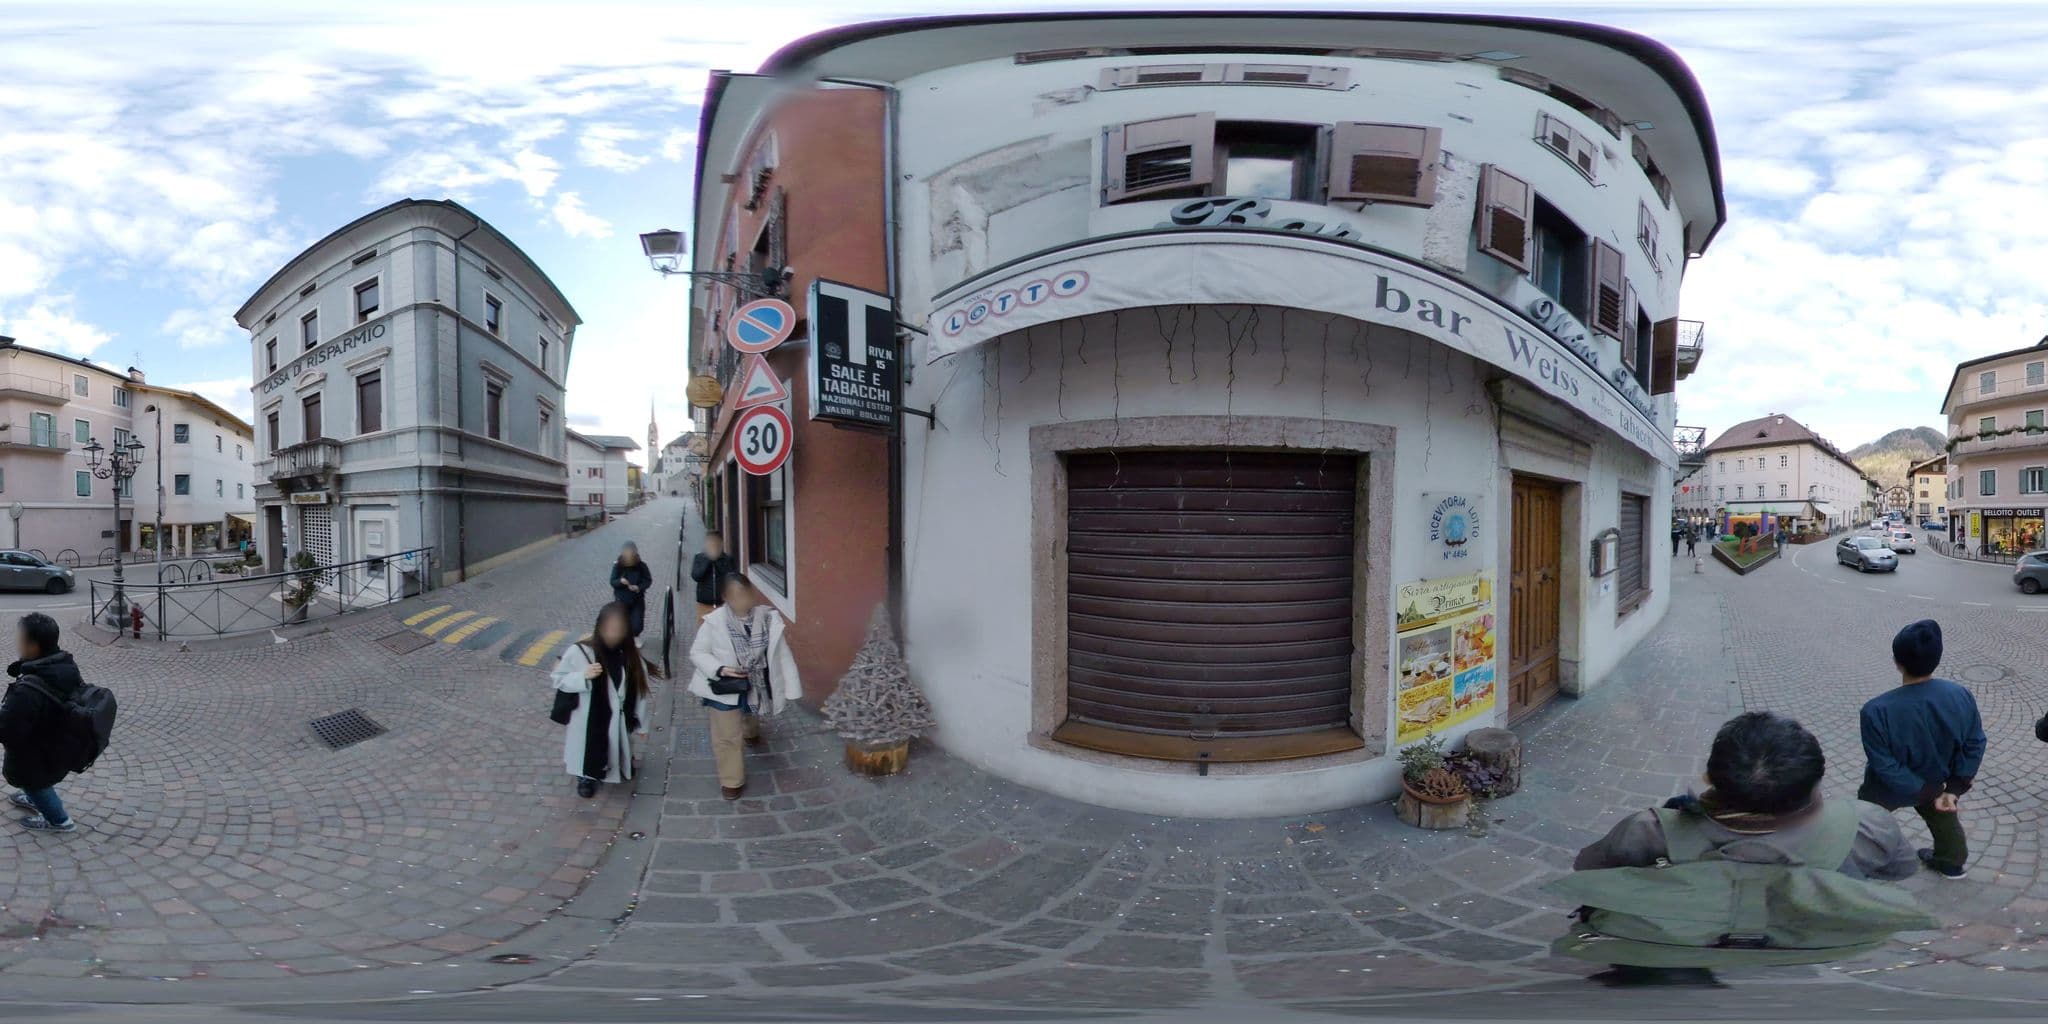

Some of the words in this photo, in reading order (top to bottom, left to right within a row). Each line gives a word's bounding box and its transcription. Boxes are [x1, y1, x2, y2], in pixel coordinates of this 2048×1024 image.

[820, 281, 891, 366] T
[1375, 274, 1472, 337] bar
[1503, 326, 1580, 397] Weiss
[263, 371, 290, 394] CASSA
[293, 361, 303, 377] DI
[307, 324, 386, 368] RISPARMIO
[876, 360, 887, 370] 15
[823, 377, 891, 403] TABACCHI
[831, 364, 866, 383] SALE
[872, 373, 881, 386] E
[821, 393, 865, 408] NAZIONALI
[866, 401, 893, 413] ESTERI
[825, 405, 855, 417] VALORI
[746, 422, 778, 456] 30
[1430, 495, 1466, 541] RICEVITORIA
[1468, 506, 1480, 538] LOTTO
